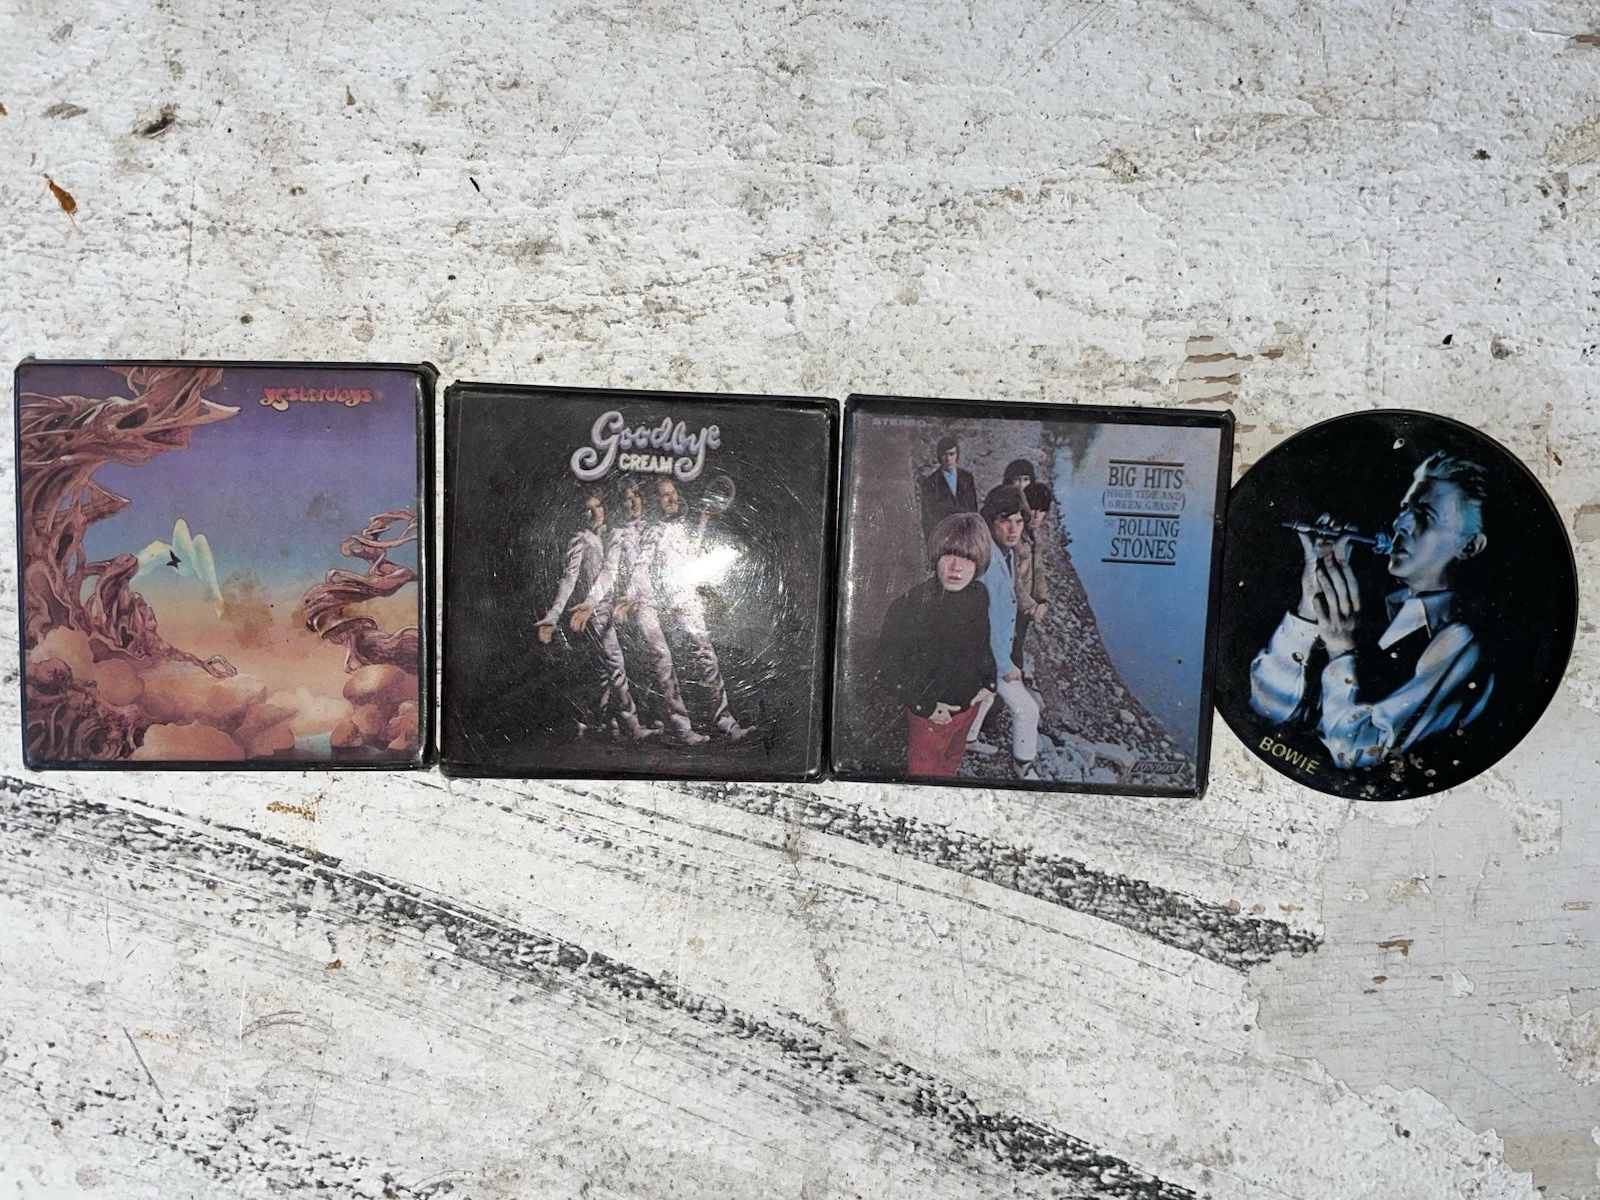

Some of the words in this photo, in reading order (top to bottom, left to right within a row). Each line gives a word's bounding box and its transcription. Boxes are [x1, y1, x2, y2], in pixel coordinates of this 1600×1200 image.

[570, 410, 722, 482] Goodbye
[618, 452, 674, 474] CREAM
[1108, 465, 1138, 487] BIG
[1143, 467, 1185, 490] HITS
[1117, 518, 1181, 538] ROLLING
[1110, 537, 1177, 560] STONES
[1259, 736, 1320, 775] BOWIE
